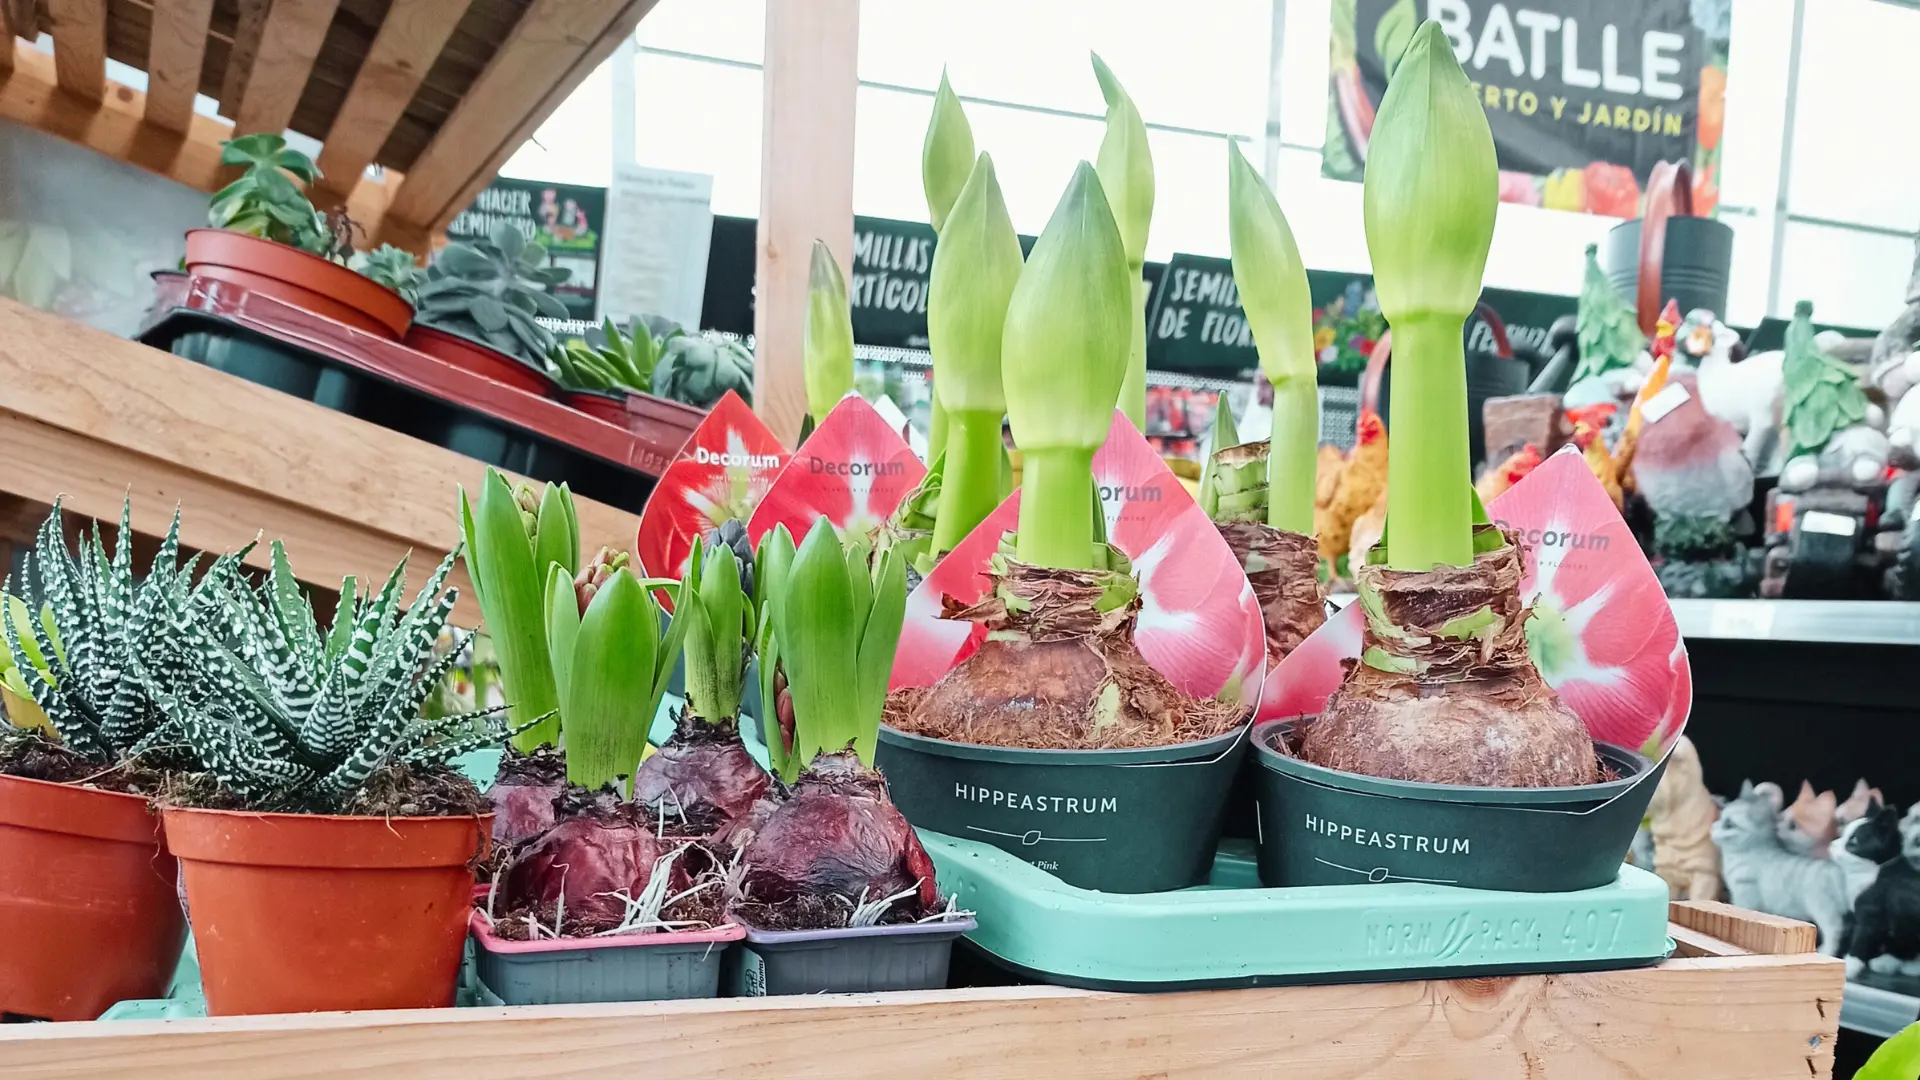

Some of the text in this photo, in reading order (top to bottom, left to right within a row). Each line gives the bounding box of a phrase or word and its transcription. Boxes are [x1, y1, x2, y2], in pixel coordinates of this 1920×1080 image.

[1428, 0, 1684, 100] BATLLE
[1471, 82, 1683, 136] ERTO Y JARDÍN
[853, 230, 931, 274] MILLAS
[852, 271, 929, 314] RTÍCOL
[1170, 268, 1242, 308] SEMIL
[1157, 306, 1192, 340] DE
[696, 446, 780, 469] Decorum
[810, 456, 905, 477] Decorum
[1100, 484, 1163, 502] orum
[955, 782, 1118, 814] HIPPEASTRUM
[1305, 813, 1470, 854] HIPPEASTRUM
[1037, 860, 1060, 870] Pink
[1560, 908, 1624, 953] 407
